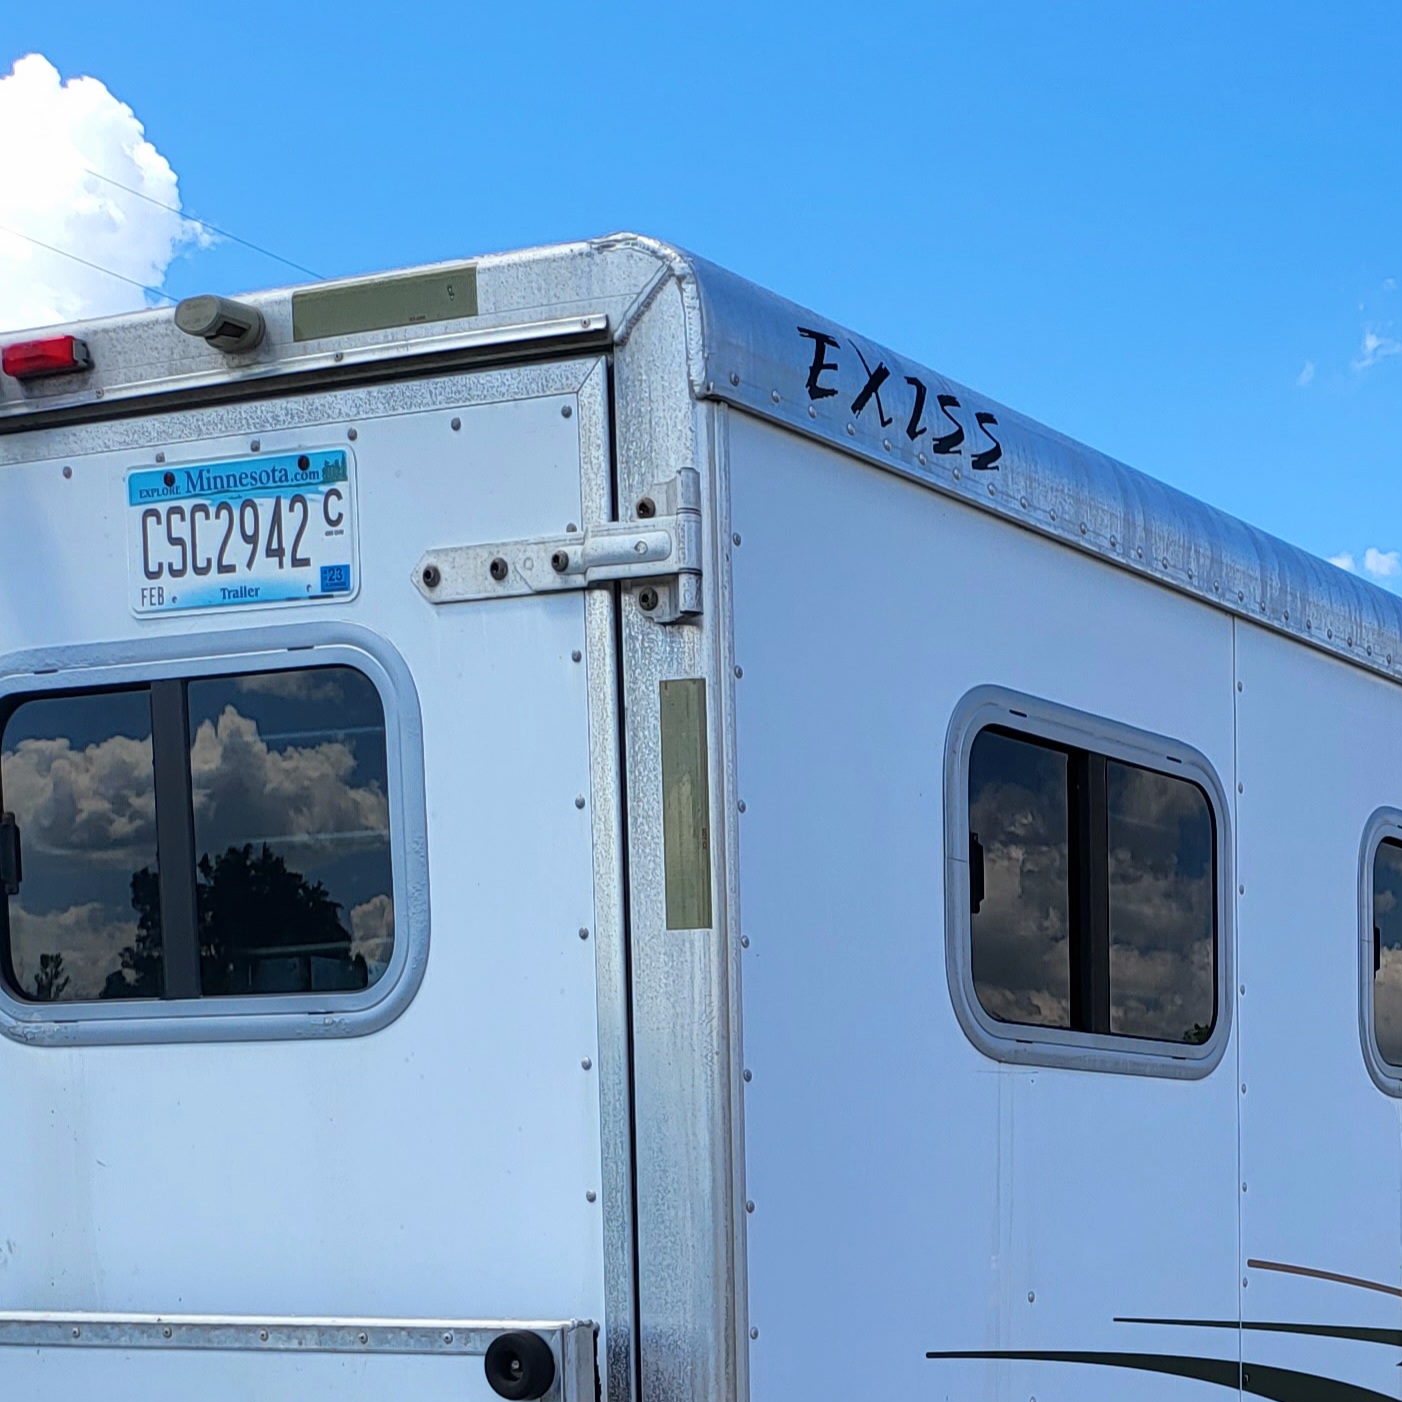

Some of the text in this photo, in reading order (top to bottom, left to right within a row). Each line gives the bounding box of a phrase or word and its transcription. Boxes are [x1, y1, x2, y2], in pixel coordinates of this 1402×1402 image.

[139, 463, 320, 499] EXPLORE Minnesota.com
[323, 488, 344, 527] C
[141, 493, 311, 580] CSC2942
[328, 568, 343, 582] 23
[141, 587, 164, 607] FEB
[220, 585, 260, 600] Trailer
